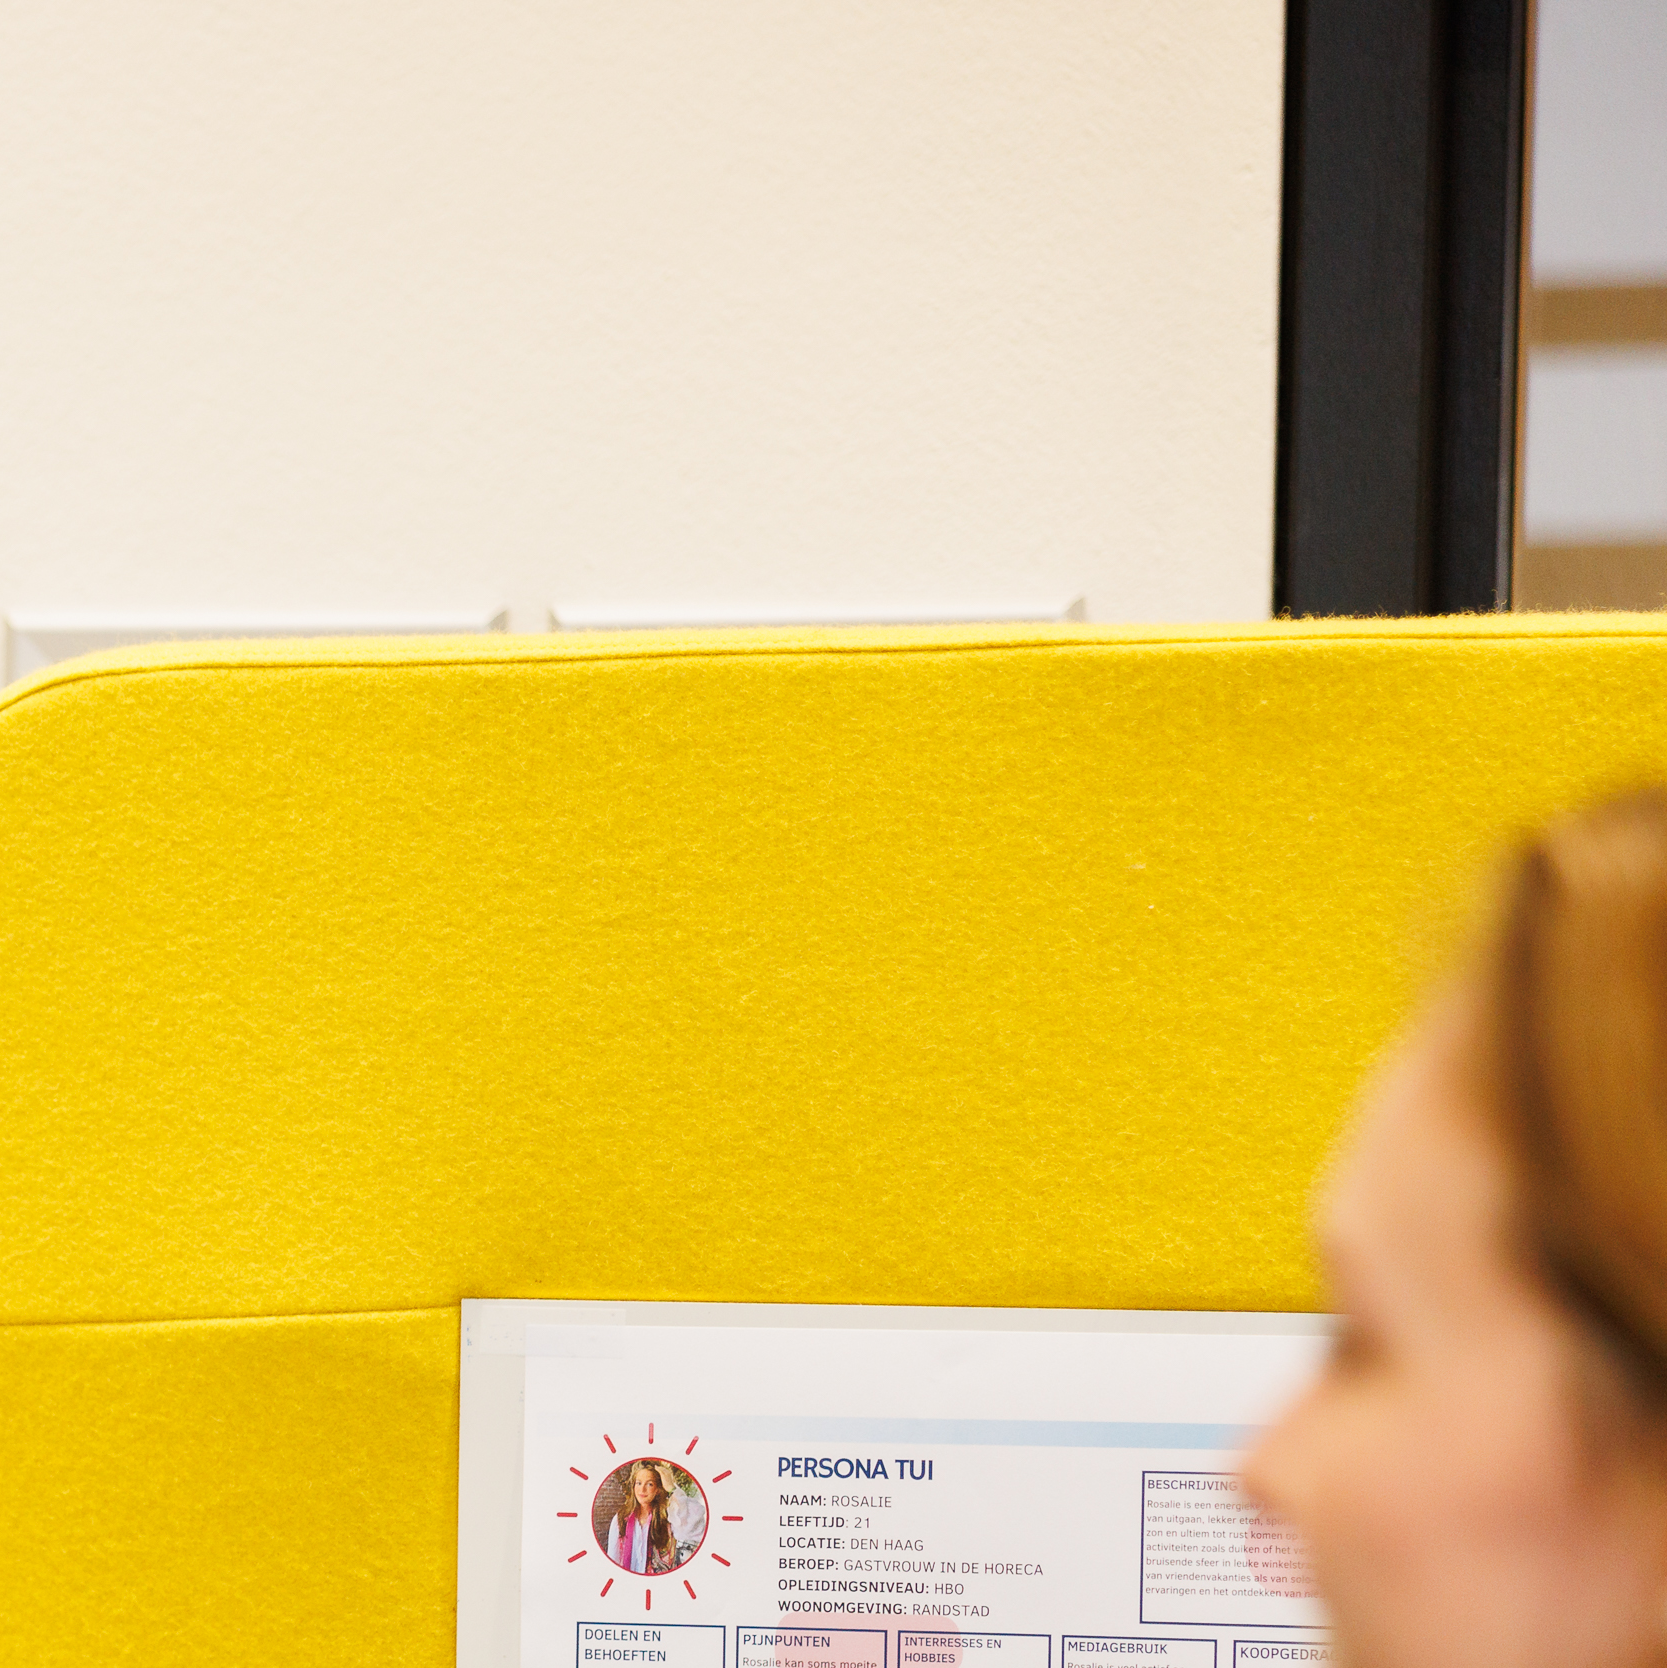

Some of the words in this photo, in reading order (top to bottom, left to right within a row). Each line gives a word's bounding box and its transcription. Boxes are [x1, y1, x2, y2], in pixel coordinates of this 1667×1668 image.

[778, 1456, 889, 1480] PERSONA
[894, 1459, 932, 1480] TUI
[1147, 1478, 1237, 1491] BESCHRIJVING
[779, 1493, 826, 1506] NAAM:
[831, 1494, 891, 1508] ROSALIE
[779, 1514, 848, 1528] LEEFTIJD:
[854, 1516, 869, 1528] 21
[779, 1536, 845, 1549] LOCATIE:
[850, 1538, 878, 1550] DEN
[884, 1538, 923, 1551] HAAG
[778, 1557, 838, 1570] BEROEP:
[843, 1558, 935, 1573] GASTVROUW
[940, 1561, 955, 1573] IN
[961, 1562, 978, 1574] DE
[984, 1562, 1043, 1575] HORECA
[778, 1578, 929, 1594] OPLEIDINGSNIVEAU:
[934, 1582, 964, 1595] HBO
[777, 1599, 907, 1615] WOONOMGEVING:
[912, 1603, 989, 1617] RANDSTAD
[584, 1627, 638, 1641] DOELEN
[643, 1629, 660, 1642] EN
[743, 1633, 830, 1647] PIJNPUNTEN
[904, 1636, 983, 1648] INTERRESSES
[986, 1638, 1001, 1649] EN
[1067, 1640, 1167, 1654] MEDIAGEBRUIK
[584, 1647, 666, 1662] BEHOEFTEN
[742, 1656, 781, 1667] Rosalie
[784, 1657, 804, 1668] kan
[807, 1660, 836, 1668] soms
